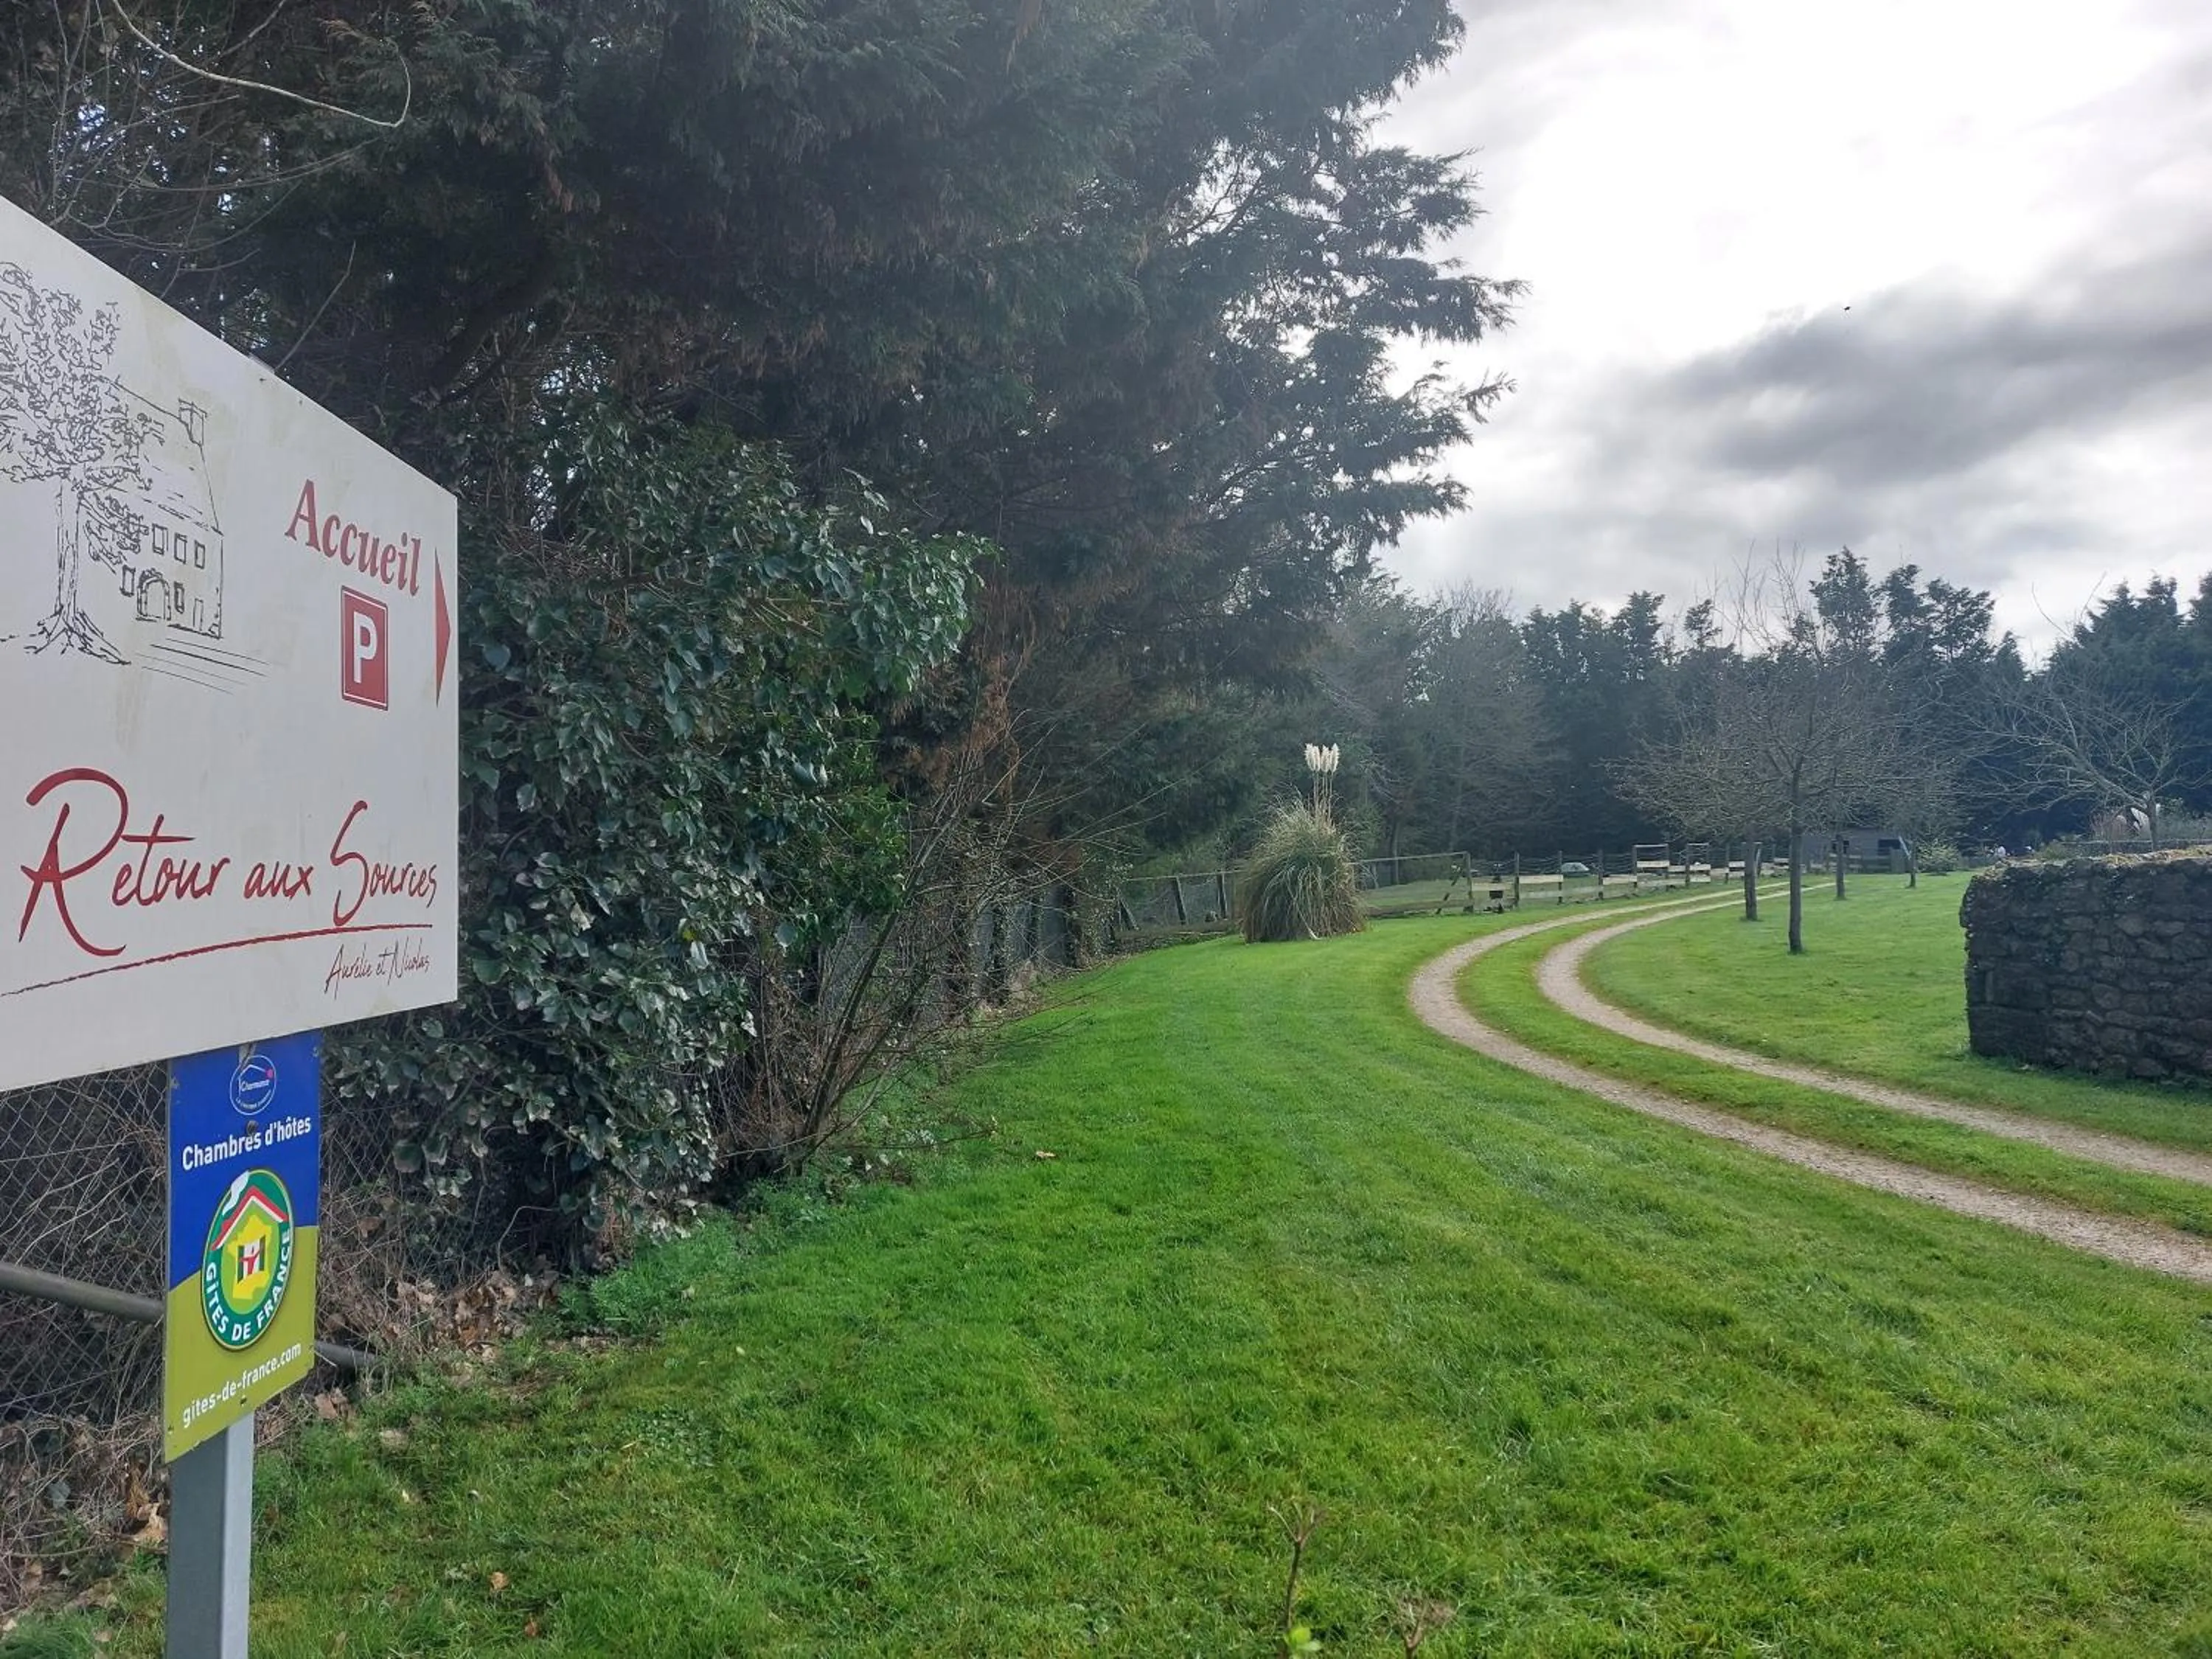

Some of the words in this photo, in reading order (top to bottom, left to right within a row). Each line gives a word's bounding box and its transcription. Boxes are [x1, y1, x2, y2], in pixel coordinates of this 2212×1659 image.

[285, 479, 421, 597] Accueil
[353, 611, 378, 684] P
[18, 767, 231, 957] Retour
[244, 861, 314, 900] aux
[330, 800, 437, 927] Sources
[375, 947, 394, 975] et
[181, 1131, 262, 1171] Chambres
[265, 1116, 312, 1147] d'hôtes
[231, 1321, 252, 1341] DE
[256, 1229, 291, 1328] FRANCE
[182, 1343, 302, 1429] gites-de-france.com
